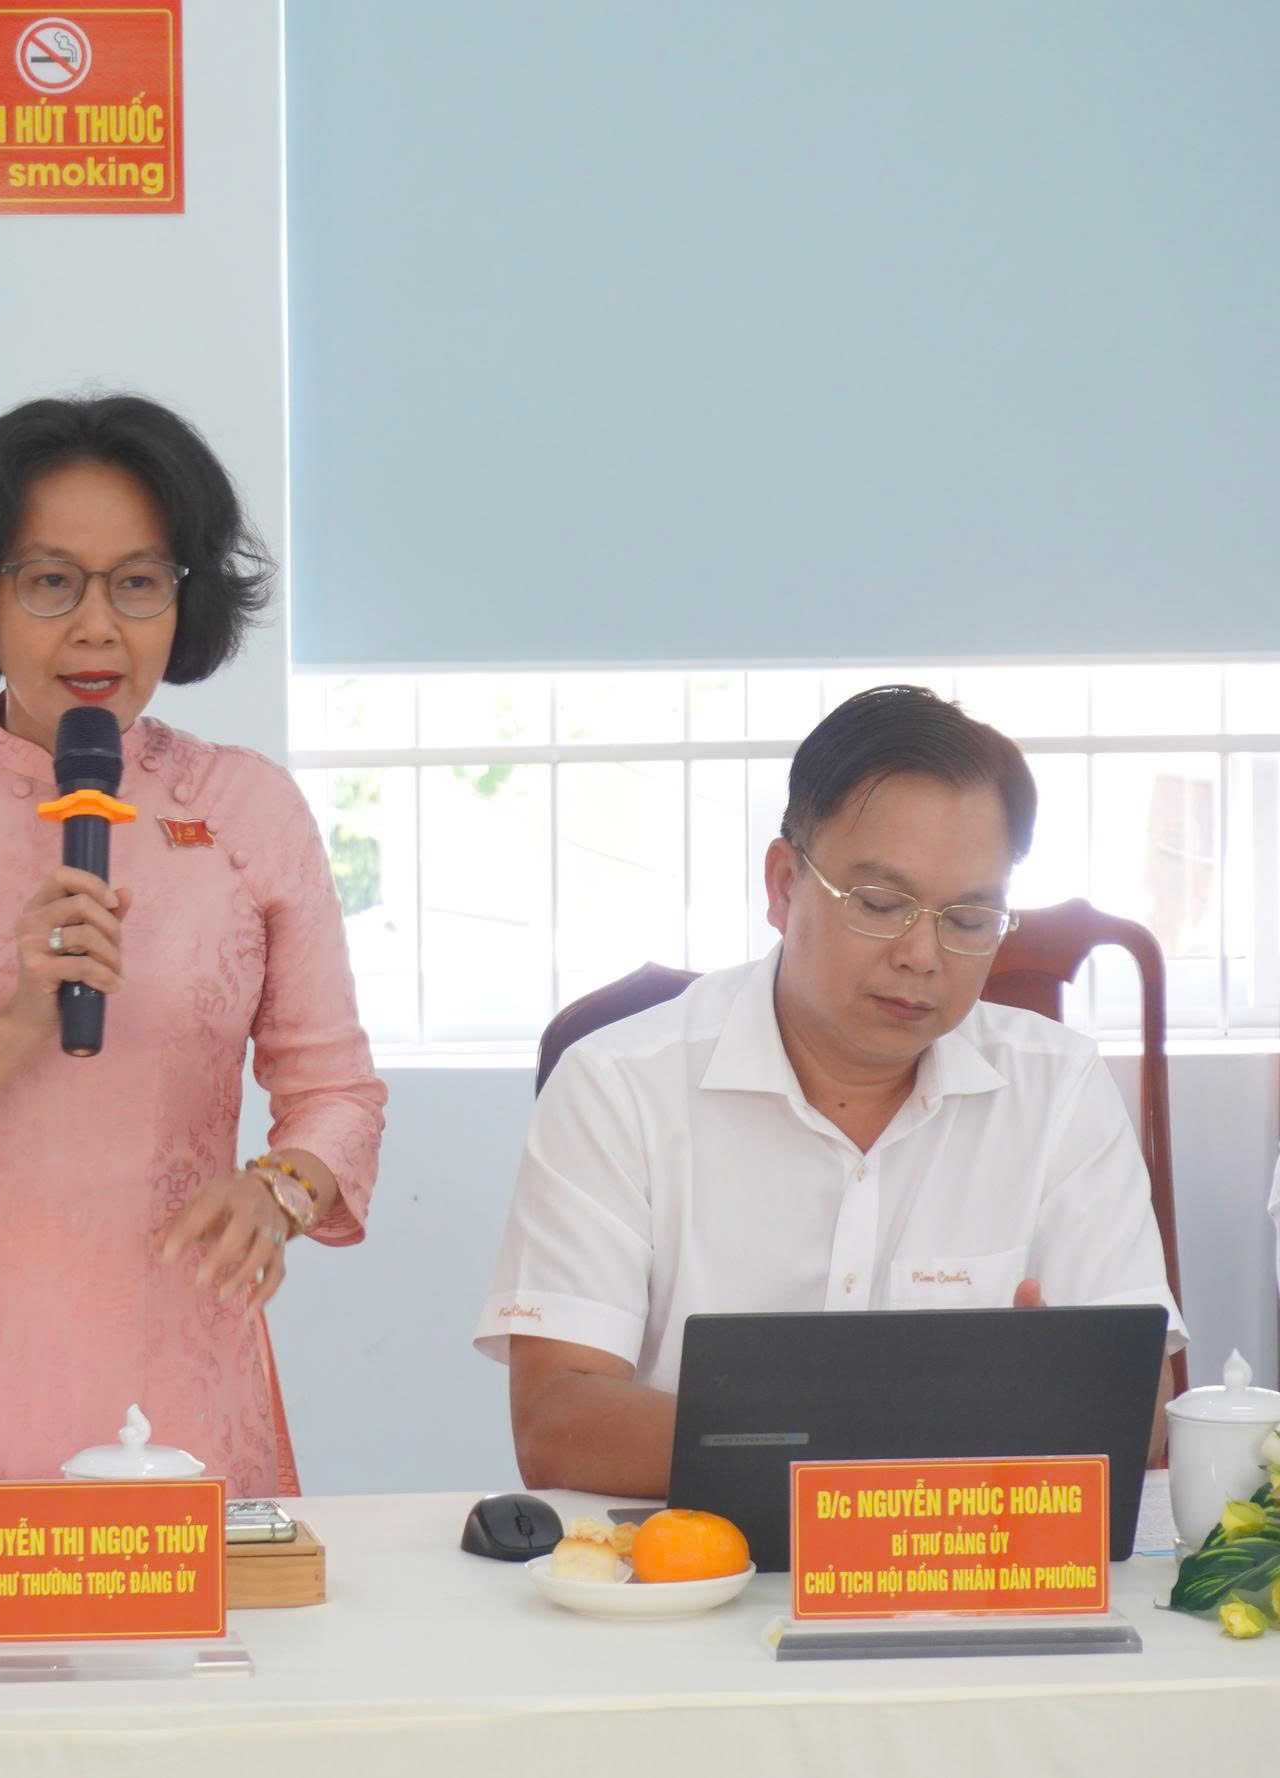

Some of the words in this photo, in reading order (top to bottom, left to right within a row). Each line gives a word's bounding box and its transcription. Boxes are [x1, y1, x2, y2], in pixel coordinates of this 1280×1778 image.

[16, 97, 67, 143] HÚT
[75, 92, 163, 143] THUỐC
[9, 156, 163, 194] smoking
[817, 1491, 851, 1518] Đ/c
[858, 1479, 941, 1517] NGUYỄN
[948, 1481, 1004, 1515] PHÚC
[1011, 1480, 1081, 1514] HOÀNG
[51, 1527, 84, 1562] THỊ
[91, 1526, 148, 1560] NGỌC
[156, 1515, 208, 1553] THỦY
[892, 1529, 907, 1556] BÍ
[912, 1531, 941, 1556] THƯ
[944, 1527, 985, 1555] ĐẢNG
[990, 1525, 1009, 1553] ỦY
[22, 1567, 82, 1595] THƯỜNG
[87, 1571, 126, 1599] TRỰC
[131, 1565, 173, 1593] ĐẢNG
[178, 1563, 196, 1593] ỦY
[805, 1563, 835, 1594] CHỦ
[841, 1571, 873, 1598] TỊCH
[877, 1570, 902, 1598] HỘI
[907, 1562, 948, 1592] ĐỒNG
[952, 1566, 994, 1591] NHÂN
[999, 1566, 1031, 1590] DÂN
[1035, 1565, 1096, 1589] PHƯỜNG
